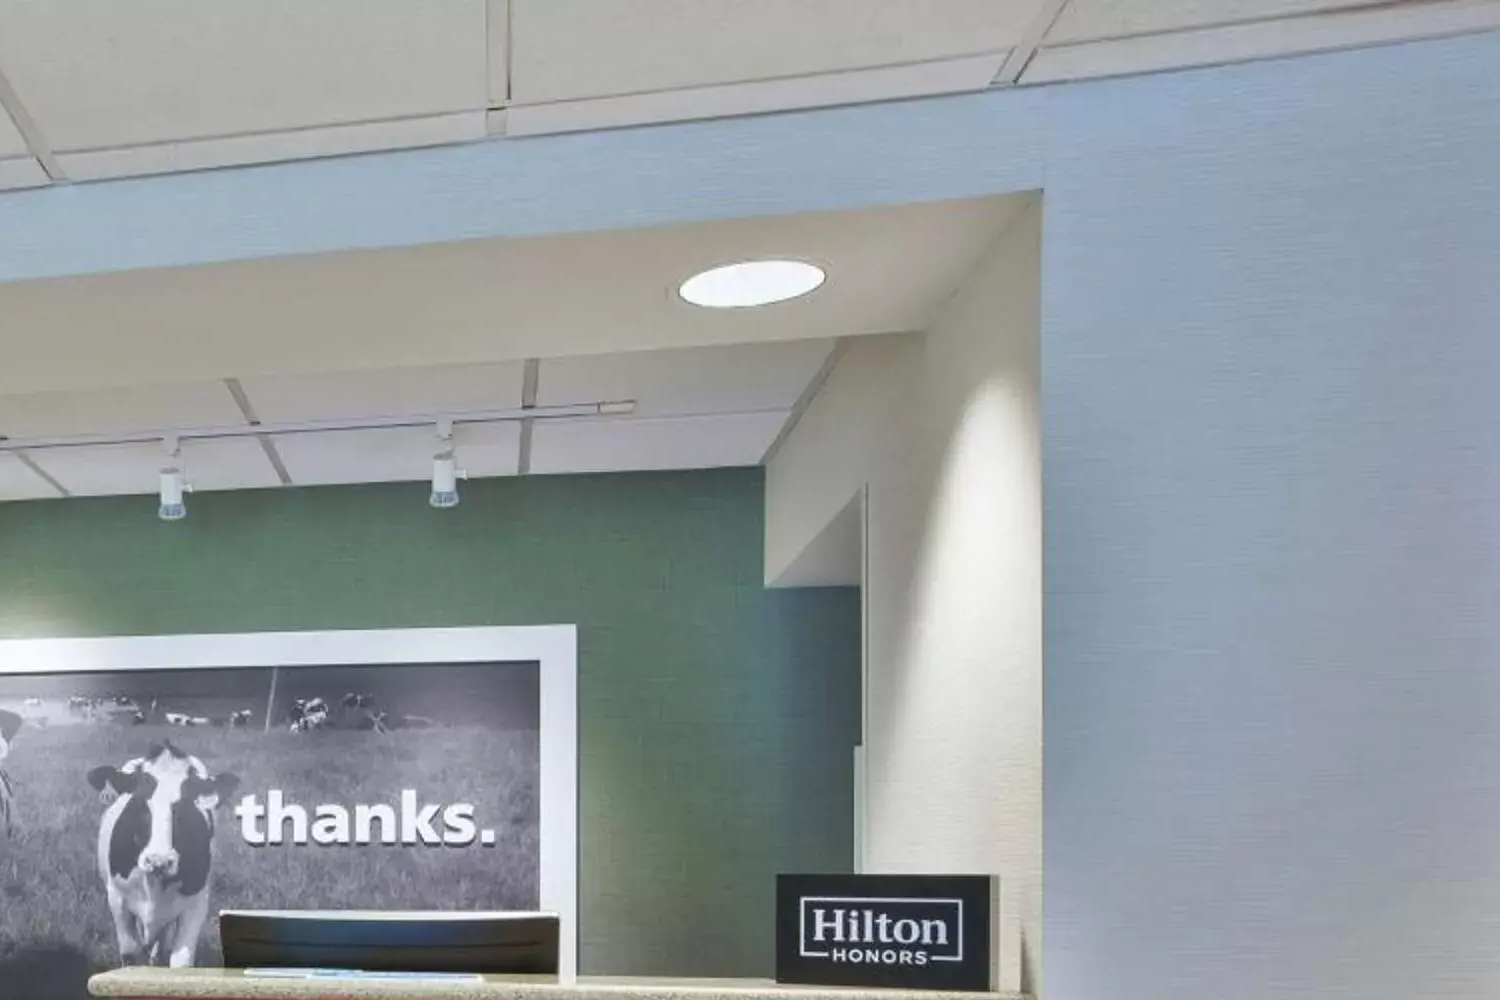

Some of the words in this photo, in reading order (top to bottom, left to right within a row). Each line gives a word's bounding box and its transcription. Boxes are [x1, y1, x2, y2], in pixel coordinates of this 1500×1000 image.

[235, 789, 495, 847] thanks.
[813, 909, 949, 945] Hilton
[832, 948, 928, 965] HONORS
